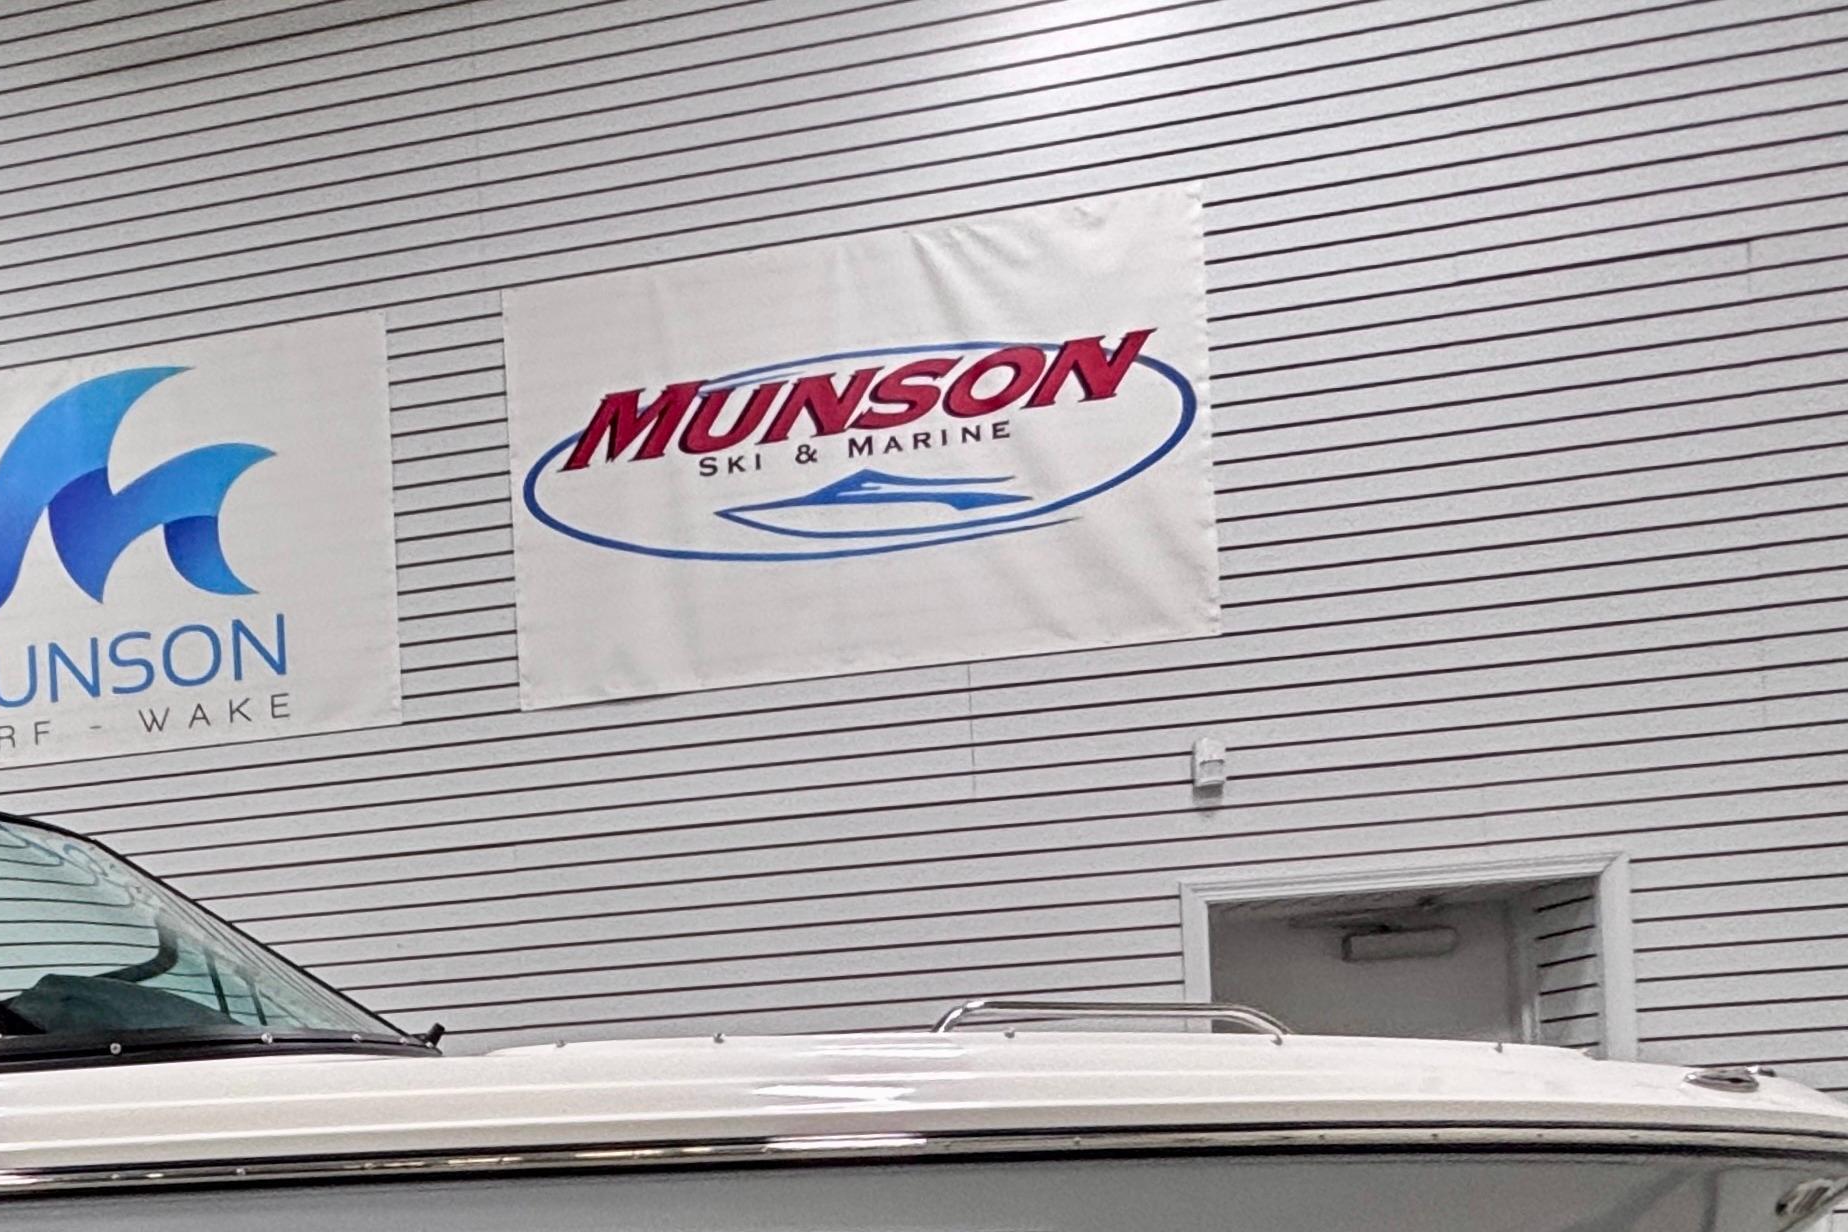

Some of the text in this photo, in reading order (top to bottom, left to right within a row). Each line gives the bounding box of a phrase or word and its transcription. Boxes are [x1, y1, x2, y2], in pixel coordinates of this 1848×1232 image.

[556, 327, 1158, 472] MUNSON
[698, 419, 1012, 478] SKI & MARINE
[138, 692, 292, 733] WAKE
